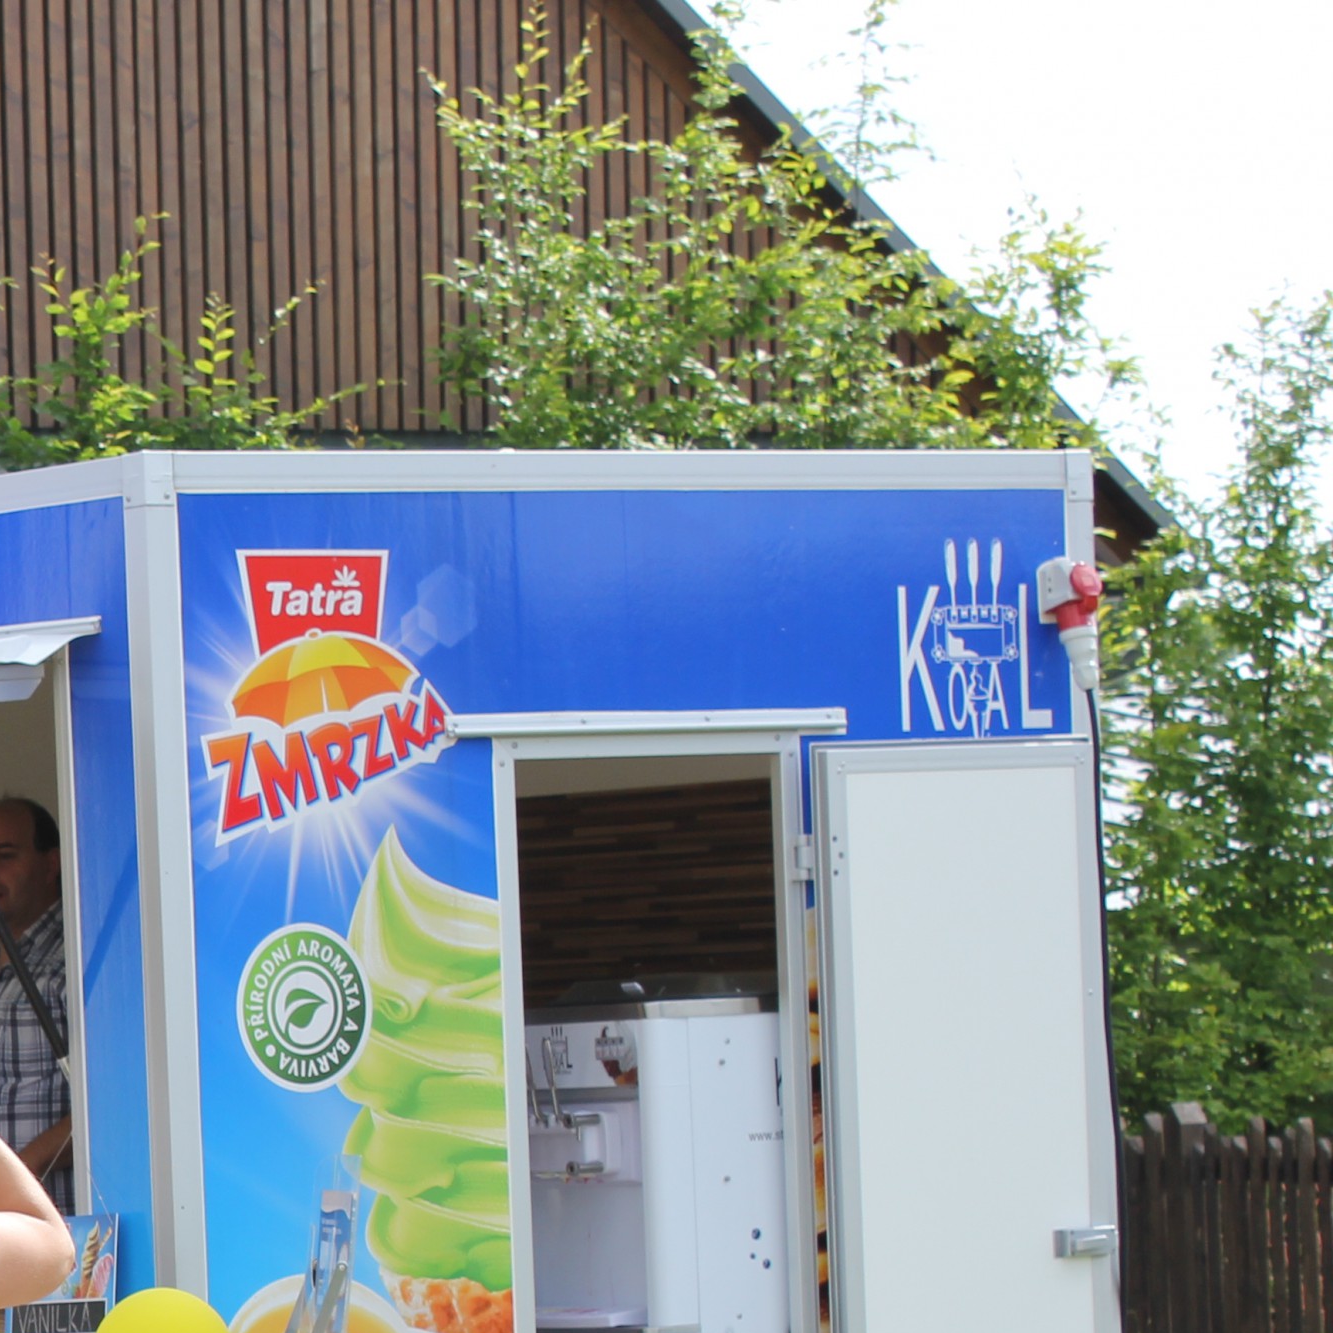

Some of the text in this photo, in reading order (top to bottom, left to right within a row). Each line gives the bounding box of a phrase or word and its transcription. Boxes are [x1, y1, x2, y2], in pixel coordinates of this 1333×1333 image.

[266, 581, 364, 617] Tatra
[207, 687, 448, 834] ZMRZKA
[246, 938, 361, 1078] PŘÍRODNÍ AROMATA A BARVIVA
